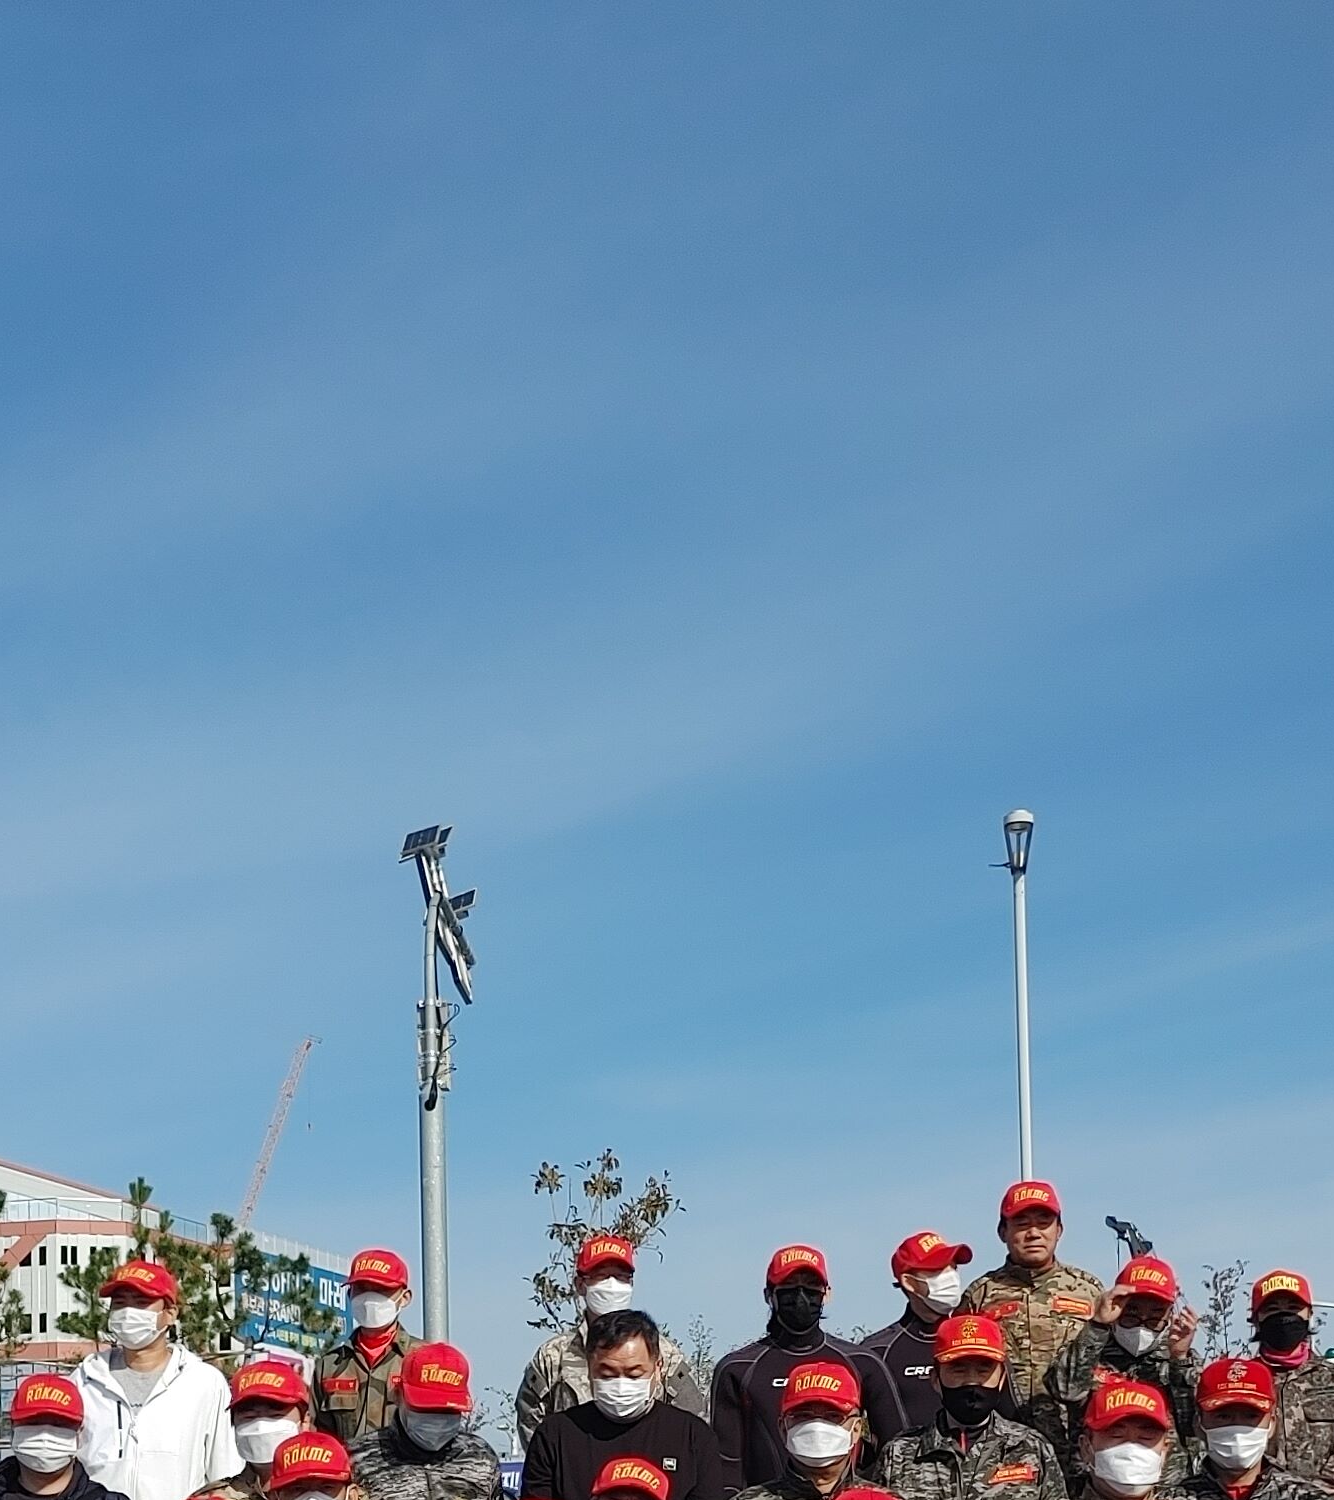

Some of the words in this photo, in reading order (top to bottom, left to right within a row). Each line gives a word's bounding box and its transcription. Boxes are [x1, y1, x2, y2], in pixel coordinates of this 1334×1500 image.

[1013, 1188, 1049, 1204] ROKMC
[590, 1242, 627, 1258] ROKMC
[355, 1260, 391, 1274] ROKMC
[1129, 1269, 1168, 1287] ROKMC
[239, 1371, 285, 1392] ROKMC
[421, 1368, 463, 1386] ROKMC
[795, 1374, 842, 1393] ROKMC
[26, 1386, 72, 1406] ROKMC
[1106, 1391, 1156, 1412] ROKMC
[283, 1445, 333, 1469] ROKMC
[611, 1464, 661, 1490] ROKMC
